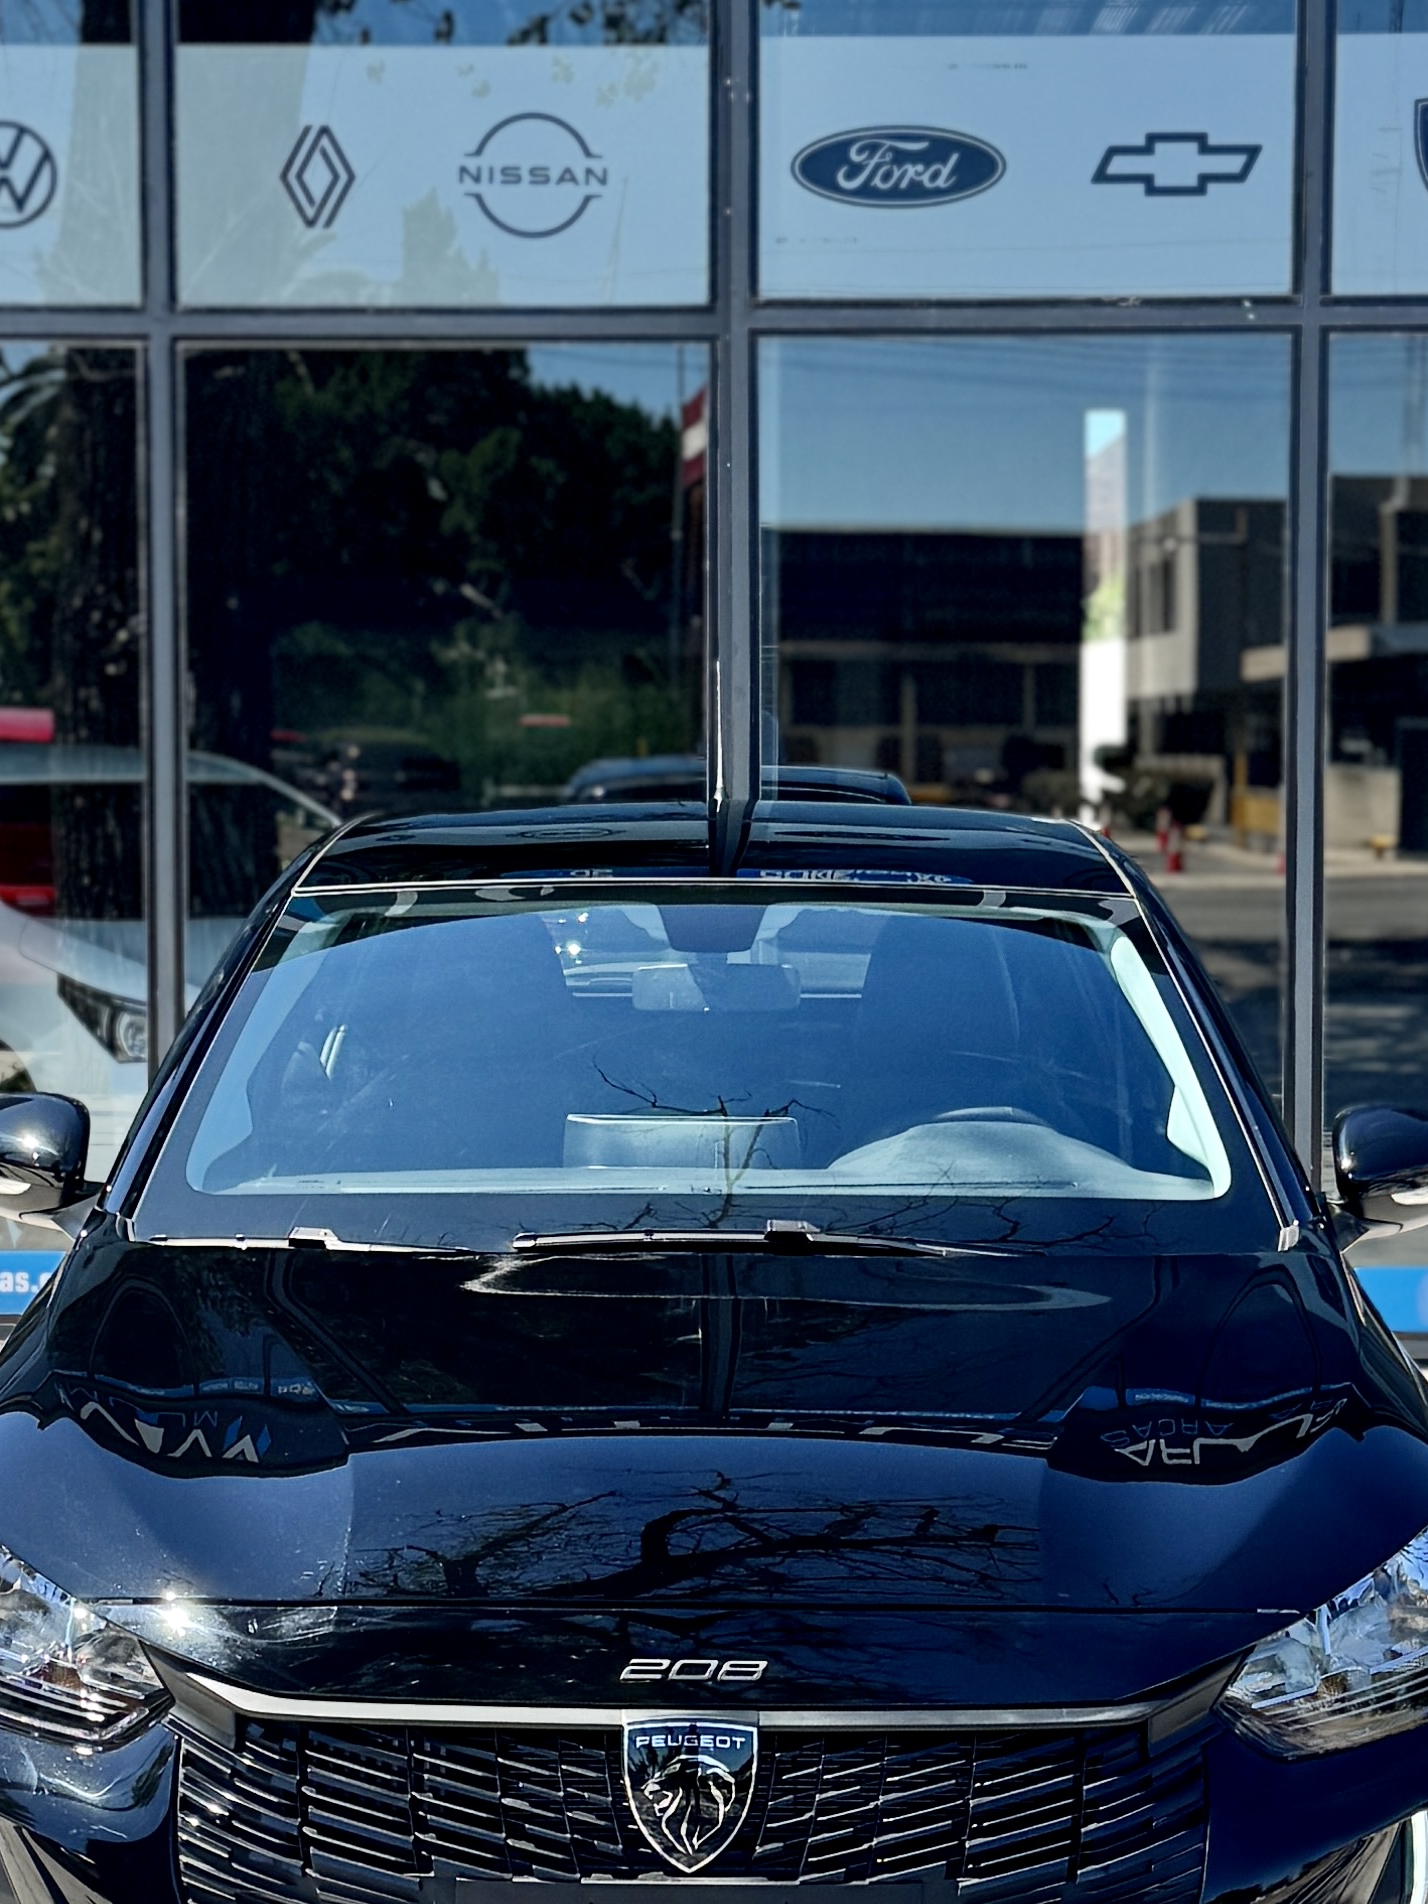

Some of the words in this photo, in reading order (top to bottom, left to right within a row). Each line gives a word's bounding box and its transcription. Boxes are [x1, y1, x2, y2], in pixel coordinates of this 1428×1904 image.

[836, 138, 961, 191] Ford
[459, 165, 608, 187] NISSAN
[620, 1658, 768, 1681] 208
[635, 1734, 746, 1750] PEUGEOT
